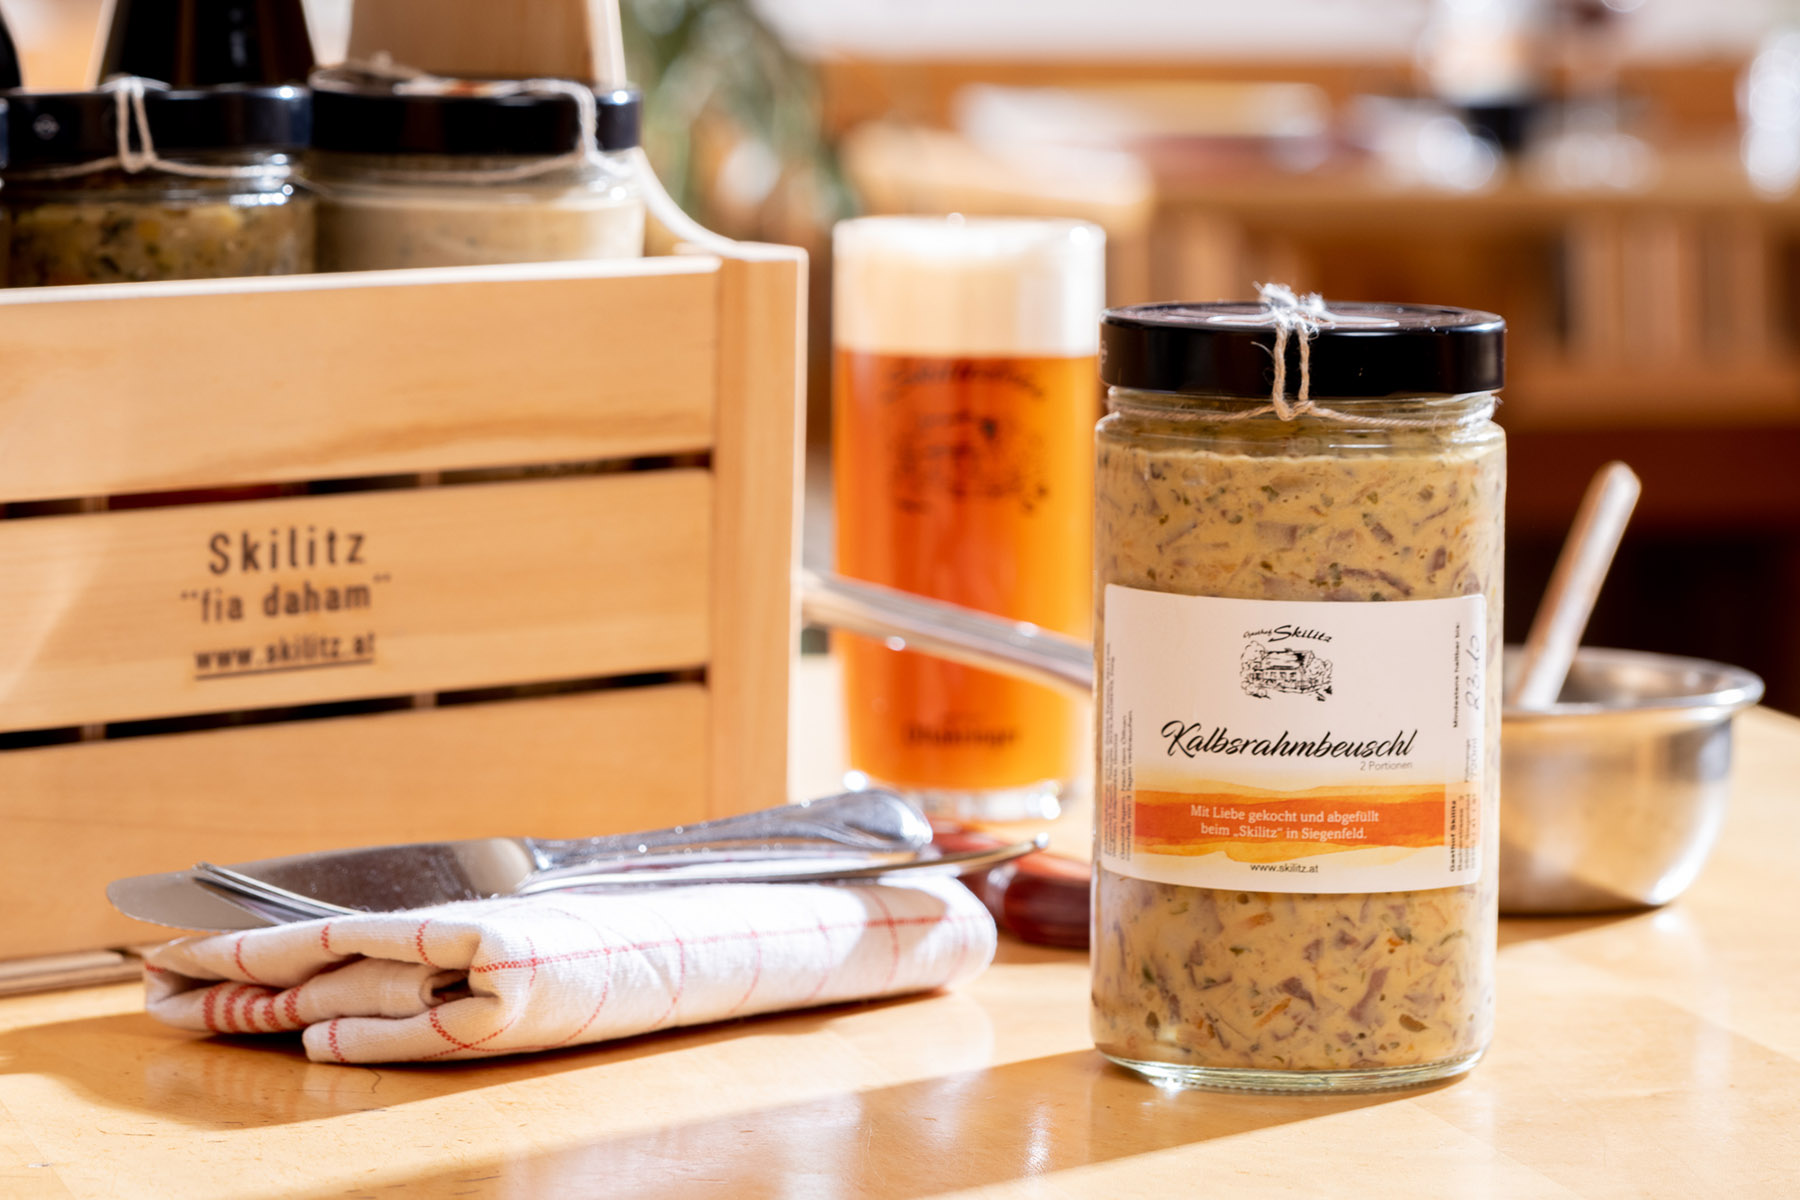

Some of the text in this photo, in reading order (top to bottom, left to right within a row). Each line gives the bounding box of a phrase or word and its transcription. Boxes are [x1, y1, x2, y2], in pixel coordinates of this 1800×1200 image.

[209, 526, 366, 575] Skilitz
[1267, 624, 1332, 643] Skilitz
[194, 631, 376, 669] www.skilitz.at
[1161, 720, 1418, 758] Kalbsrahmbeuschl
[1360, 760, 1413, 772] 2 Portionen
[1191, 804, 1379, 825] Mit Liebe gekocht und abgefüllt
[1201, 822, 1230, 836] beim
[1286, 827, 1298, 839] in
[1301, 827, 1368, 842] Siegenfeld.
[1250, 863, 1319, 874] www.skilitz.at
